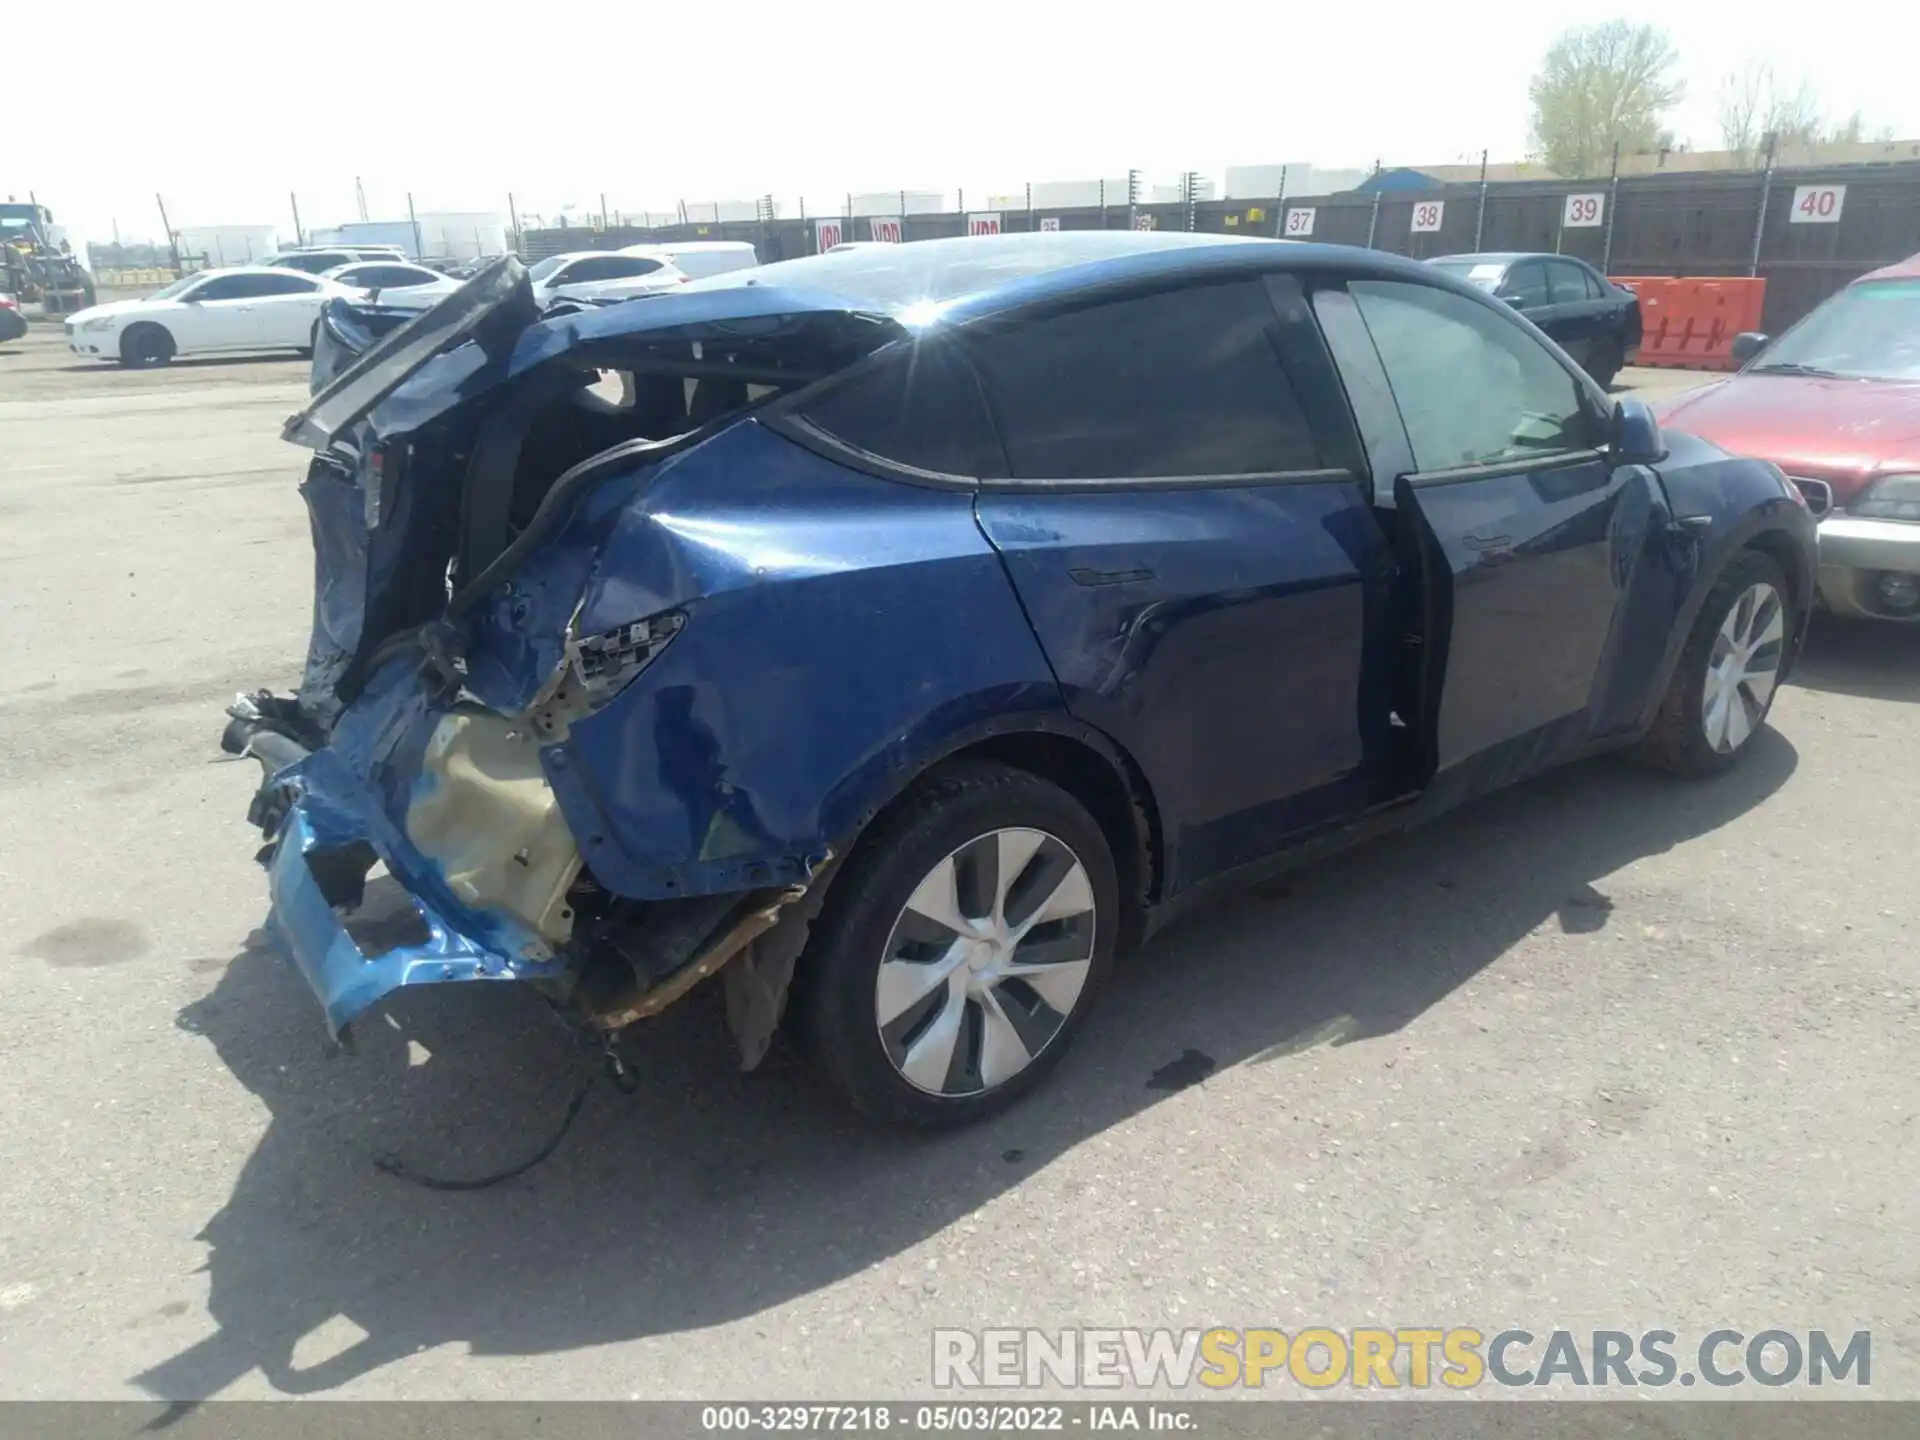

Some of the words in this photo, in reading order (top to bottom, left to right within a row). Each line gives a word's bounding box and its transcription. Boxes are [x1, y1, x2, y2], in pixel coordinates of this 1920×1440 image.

[1570, 198, 1597, 221] 39
[1799, 190, 1835, 217] 40
[1289, 211, 1311, 231] 37
[1416, 205, 1438, 227] 38
